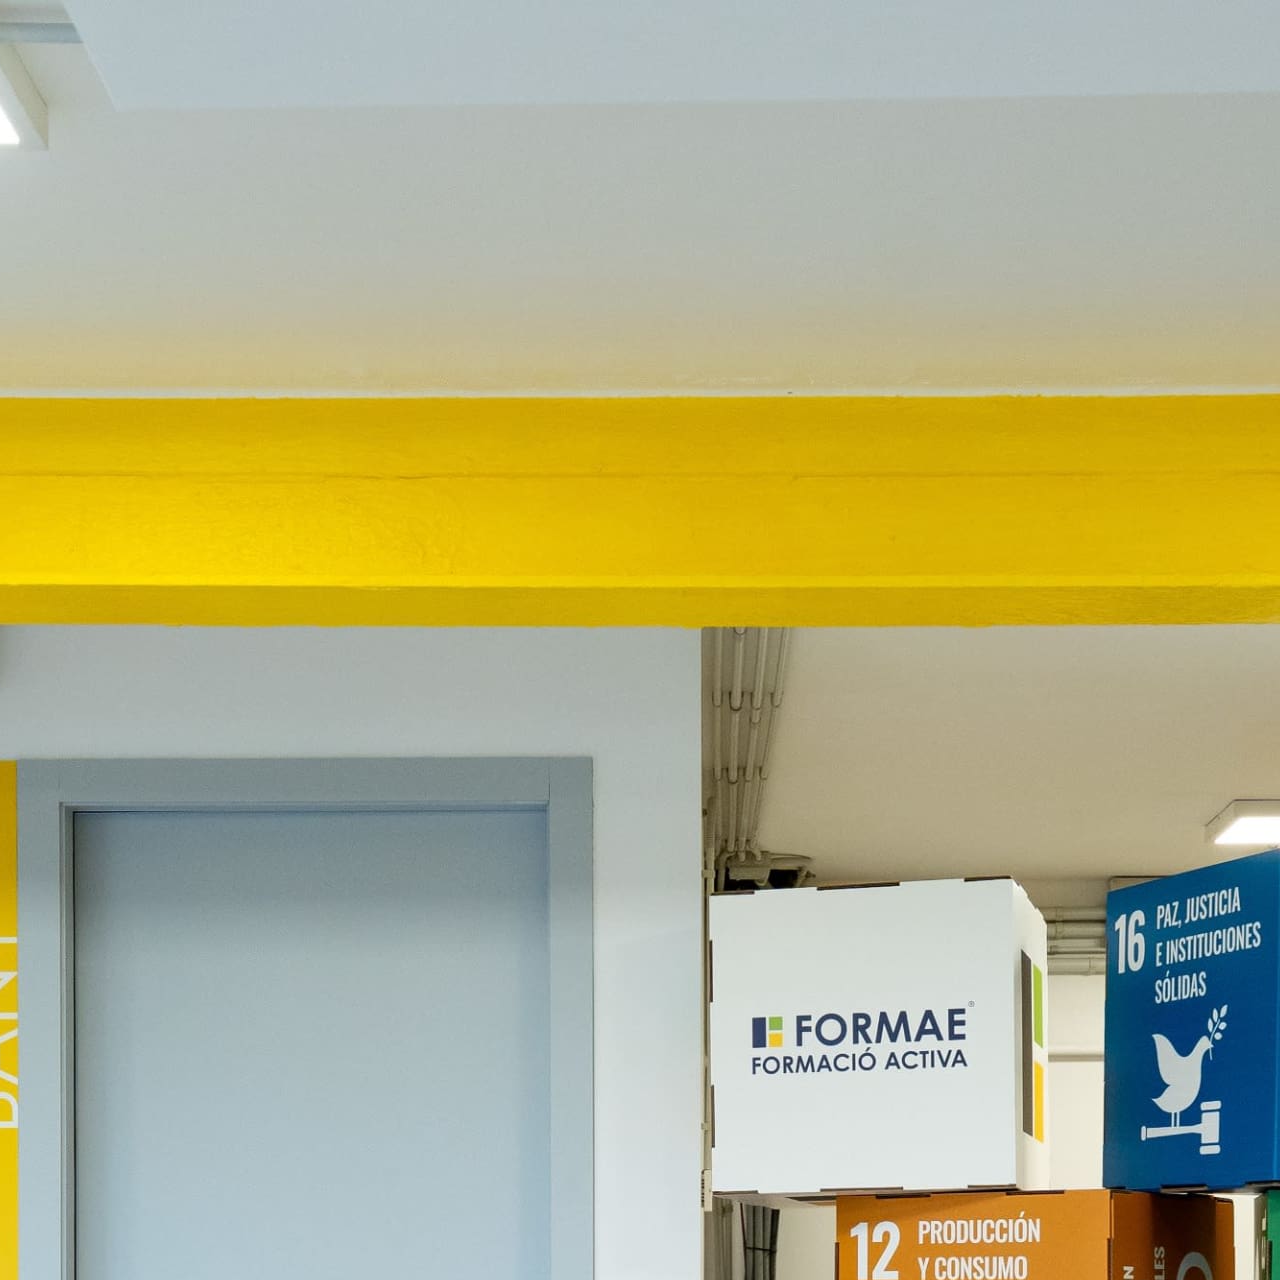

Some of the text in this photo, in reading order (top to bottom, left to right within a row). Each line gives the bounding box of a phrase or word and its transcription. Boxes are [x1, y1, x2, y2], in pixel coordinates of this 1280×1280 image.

[1115, 887, 1240, 974] 16 PAZ, JUSTICIA
[1156, 921, 1261, 967] E INSTITUCIONES
[1155, 970, 1206, 1003] SÓLIDAS
[796, 1008, 966, 1046] FORMAE
[752, 1047, 967, 1074] FORMACIÓ ACTIVA
[850, 1211, 1040, 1280] 12 PRODUCCIÓN
[918, 1256, 1028, 1280] Y CONSUMO
